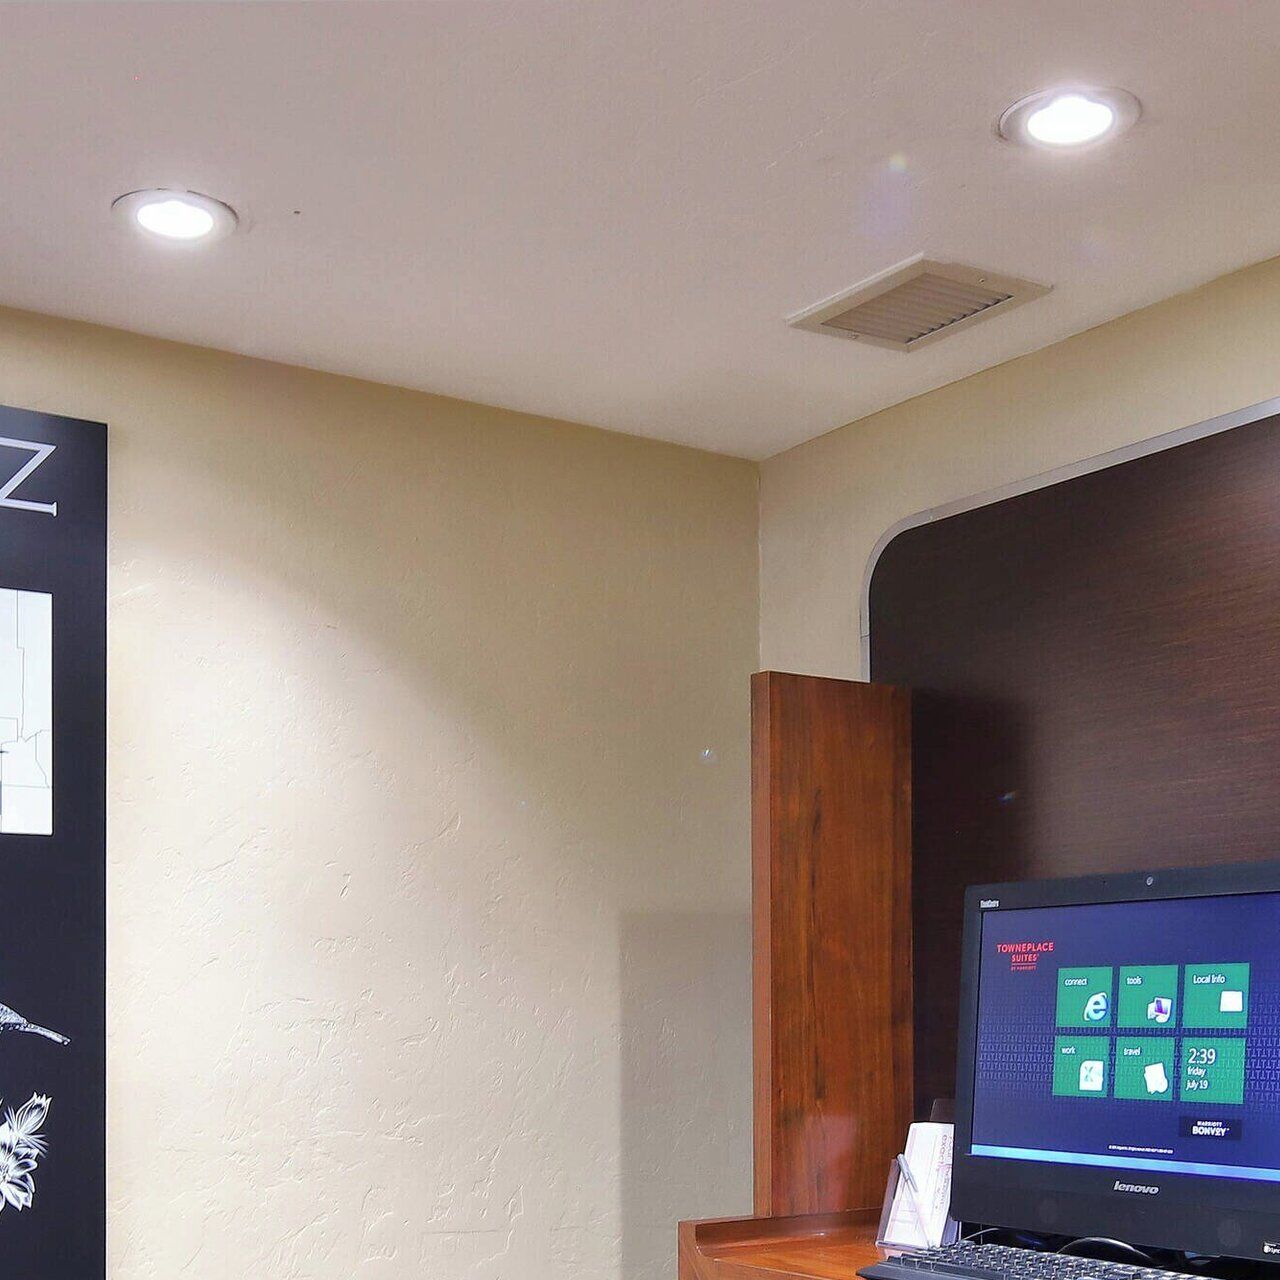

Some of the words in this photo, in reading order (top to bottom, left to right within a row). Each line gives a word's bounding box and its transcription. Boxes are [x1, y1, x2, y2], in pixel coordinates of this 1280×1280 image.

[996, 942, 1054, 953] TOWNEPLACE
[1065, 977, 1087, 986] connect
[1126, 976, 1143, 985] tools
[1193, 974, 1210, 984] Local
[1212, 974, 1225, 984] Info
[1061, 1046, 1076, 1054] work
[1124, 1047, 1140, 1056] travel
[1187, 1048, 1216, 1064] 2:39
[1187, 1066, 1206, 1078] friday
[1199, 1079, 1208, 1089] 19
[1192, 1126, 1226, 1137] BONVOY
[1113, 1181, 1160, 1195] lenovo
